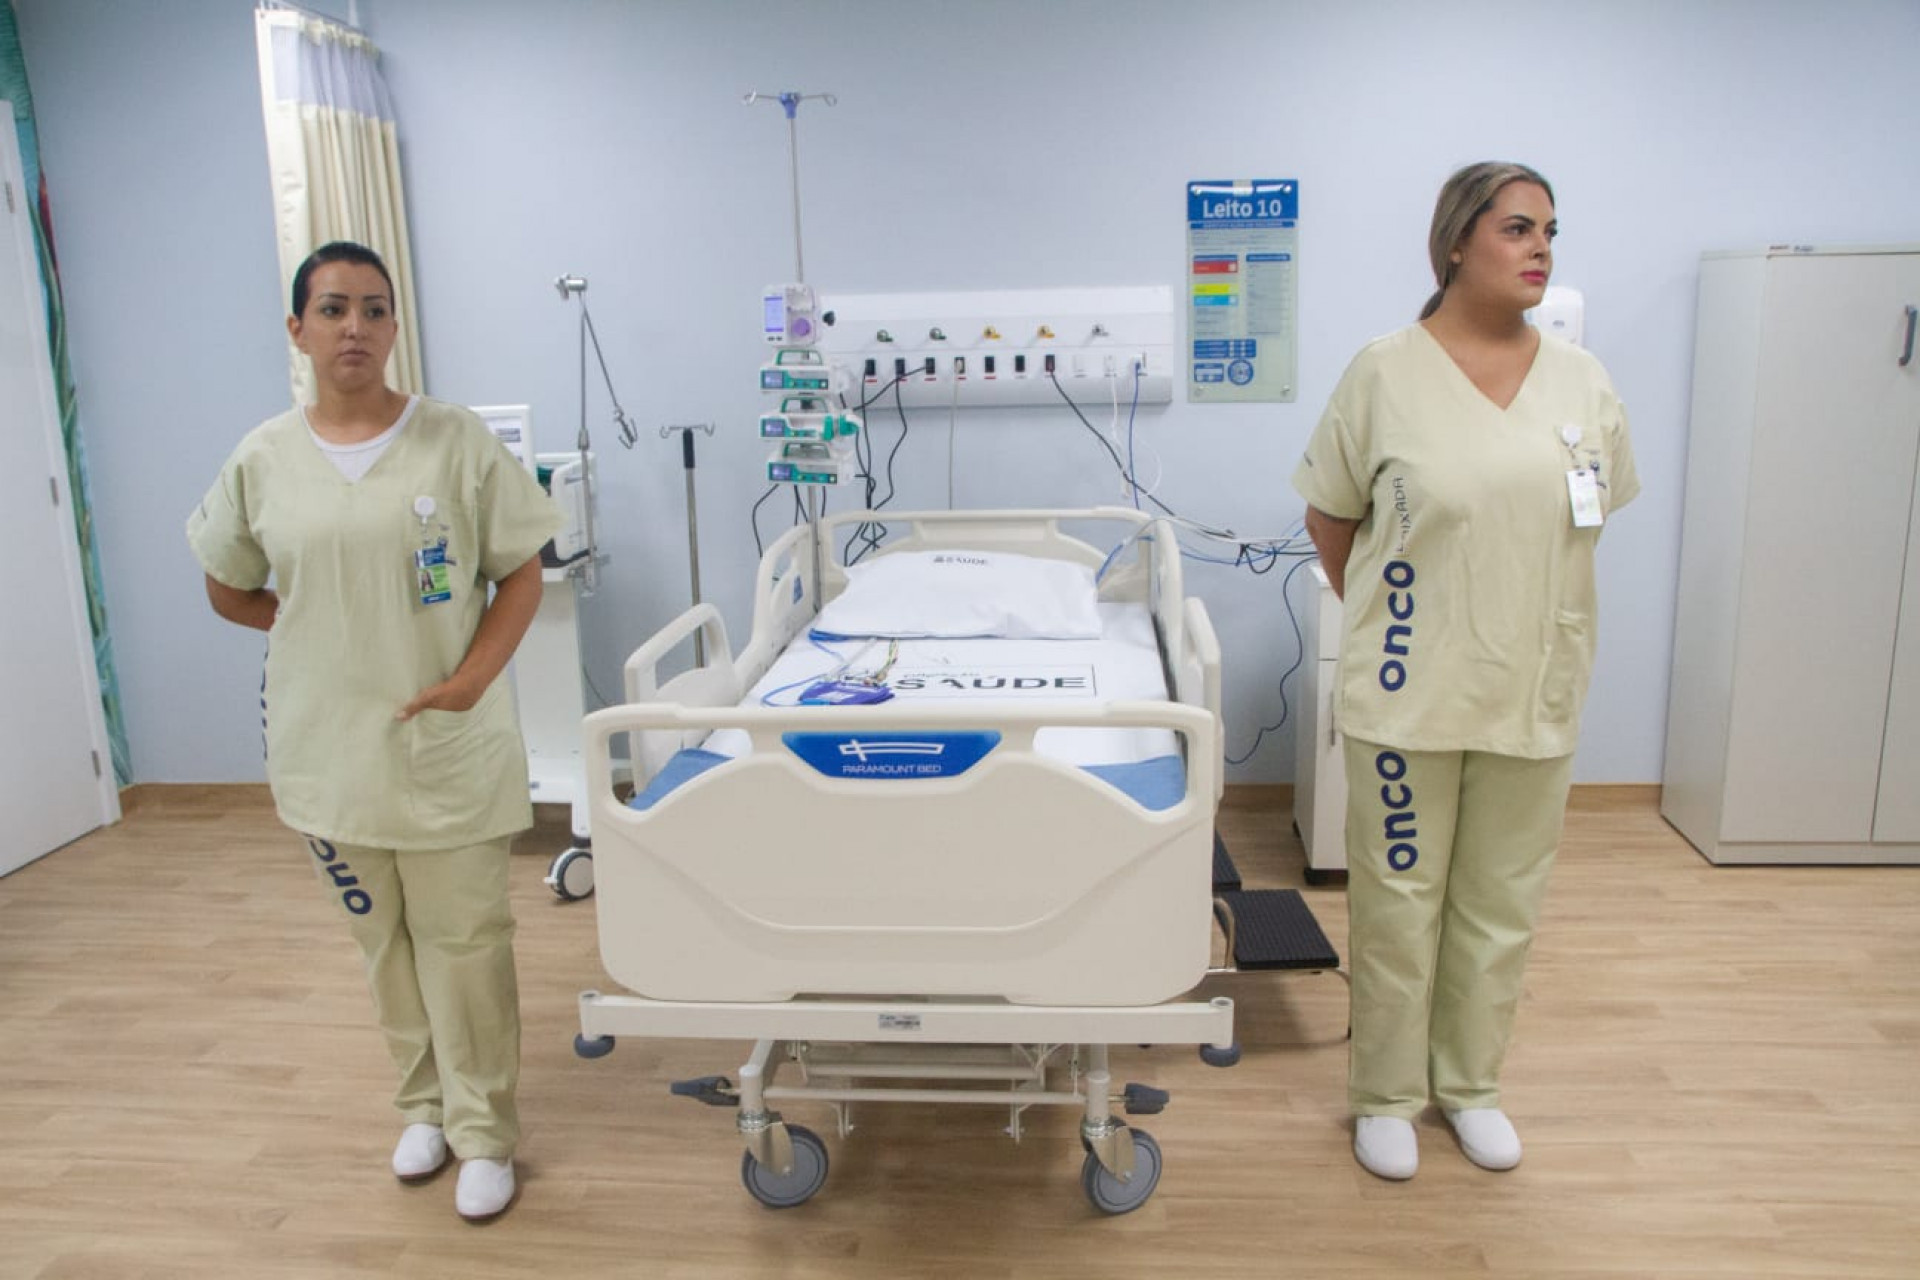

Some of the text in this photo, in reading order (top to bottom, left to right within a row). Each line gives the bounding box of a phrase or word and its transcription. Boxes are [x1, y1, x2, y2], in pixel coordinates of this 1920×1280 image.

[1203, 199, 1282, 218] Leito 10
[1379, 559, 1416, 692] onco
[842, 764, 942, 774] PARAMOUNT BED
[1375, 750, 1419, 871] onco
[302, 833, 372, 914] onc
